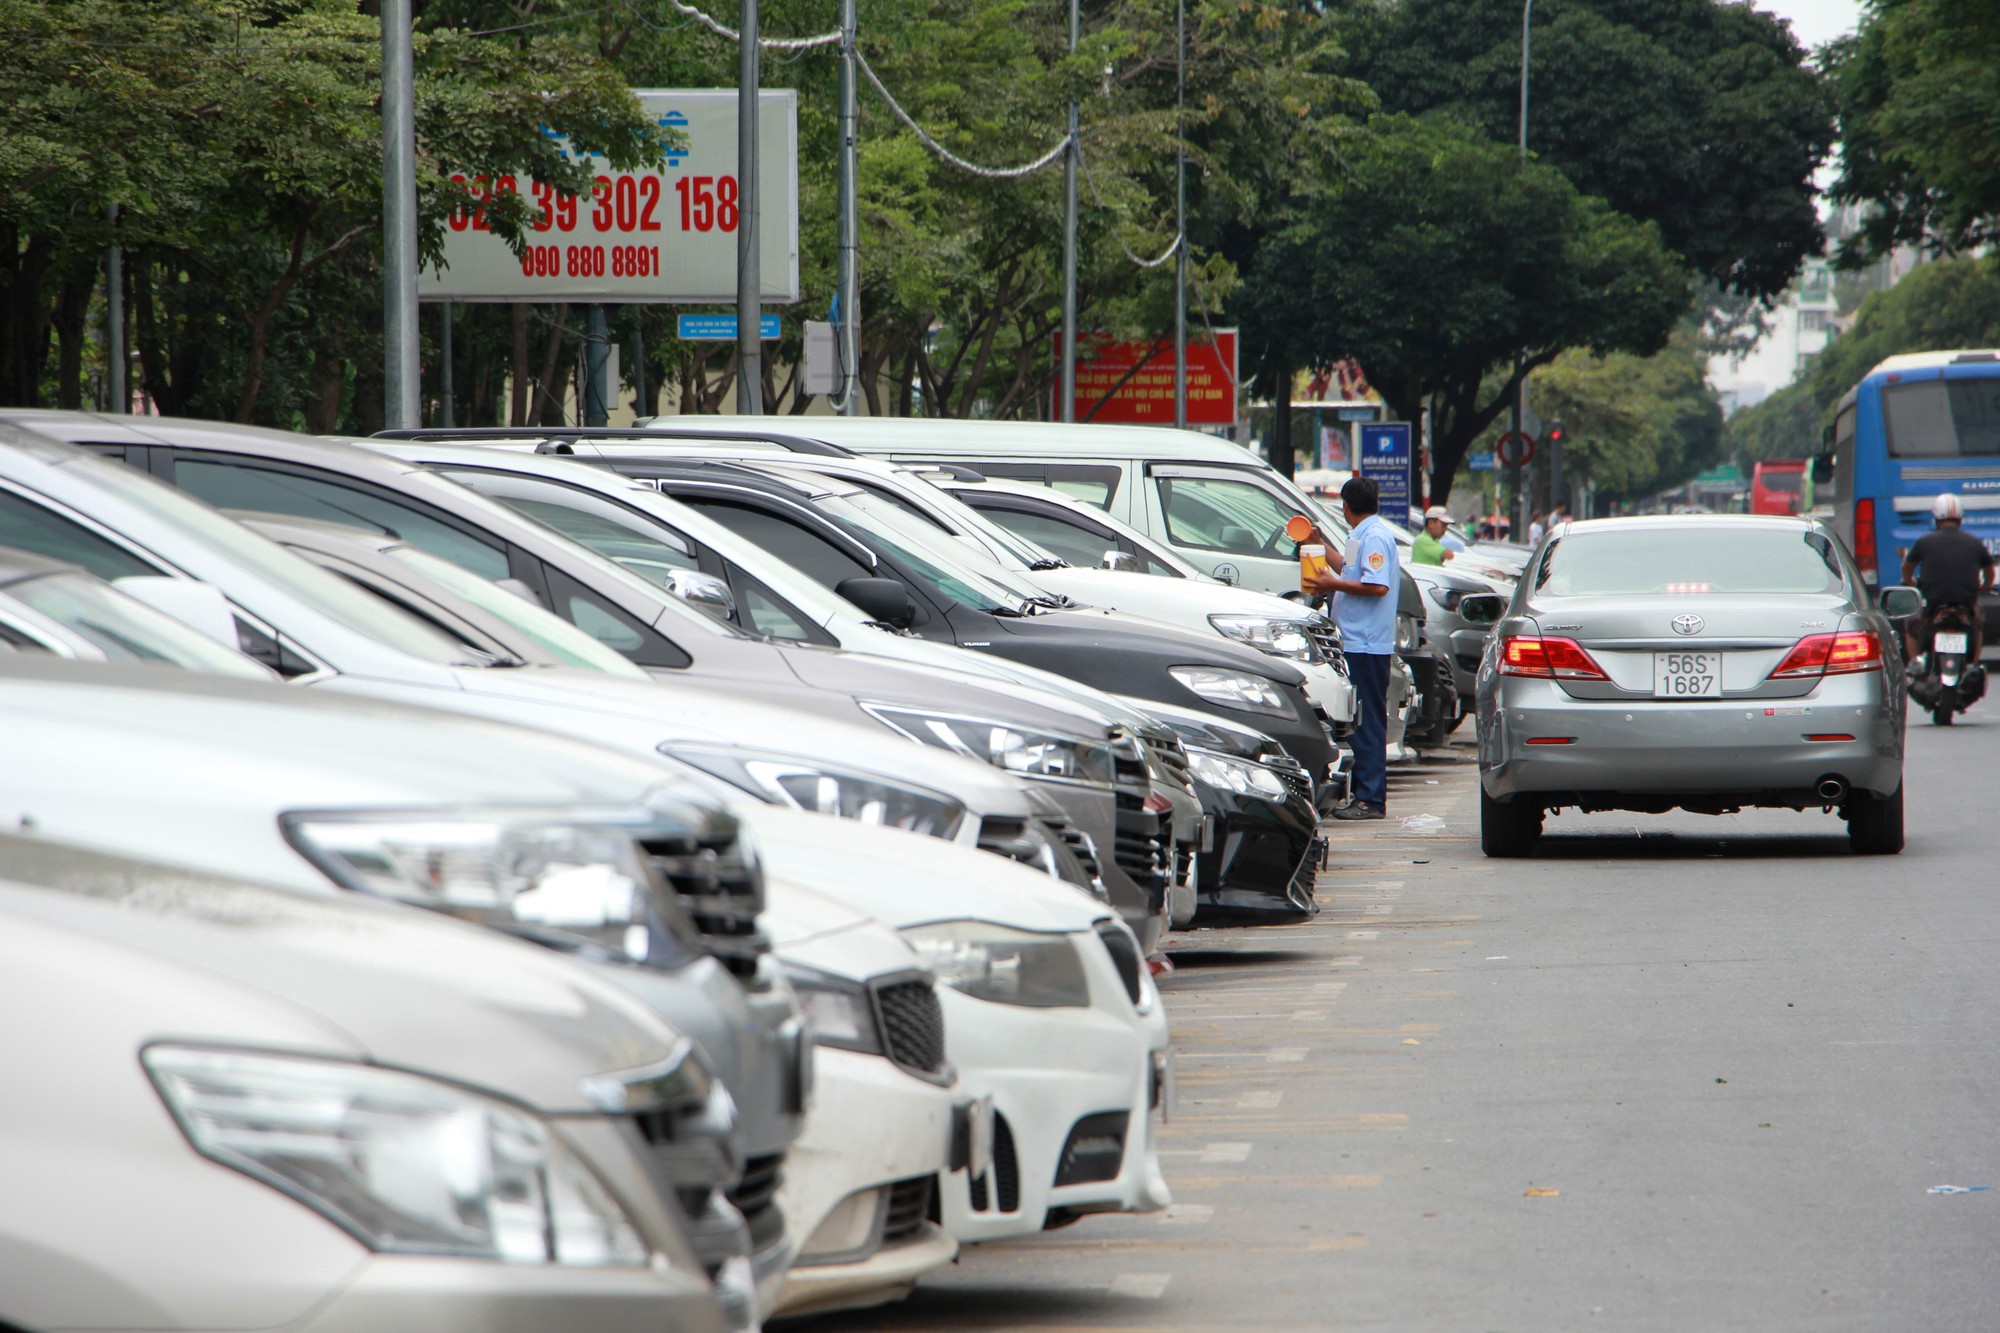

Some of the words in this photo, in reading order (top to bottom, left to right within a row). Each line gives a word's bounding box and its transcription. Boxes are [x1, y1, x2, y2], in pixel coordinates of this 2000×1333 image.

[531, 175, 578, 232] 39
[592, 175, 661, 232] 302
[675, 175, 739, 232] 158
[522, 245, 560, 277] 090
[567, 245, 605, 277] 880
[612, 245, 659, 277] 8891
[1380, 437, 1390, 450] P
[1668, 654, 1707, 674] 56S
[1663, 676, 1714, 694] 1687
